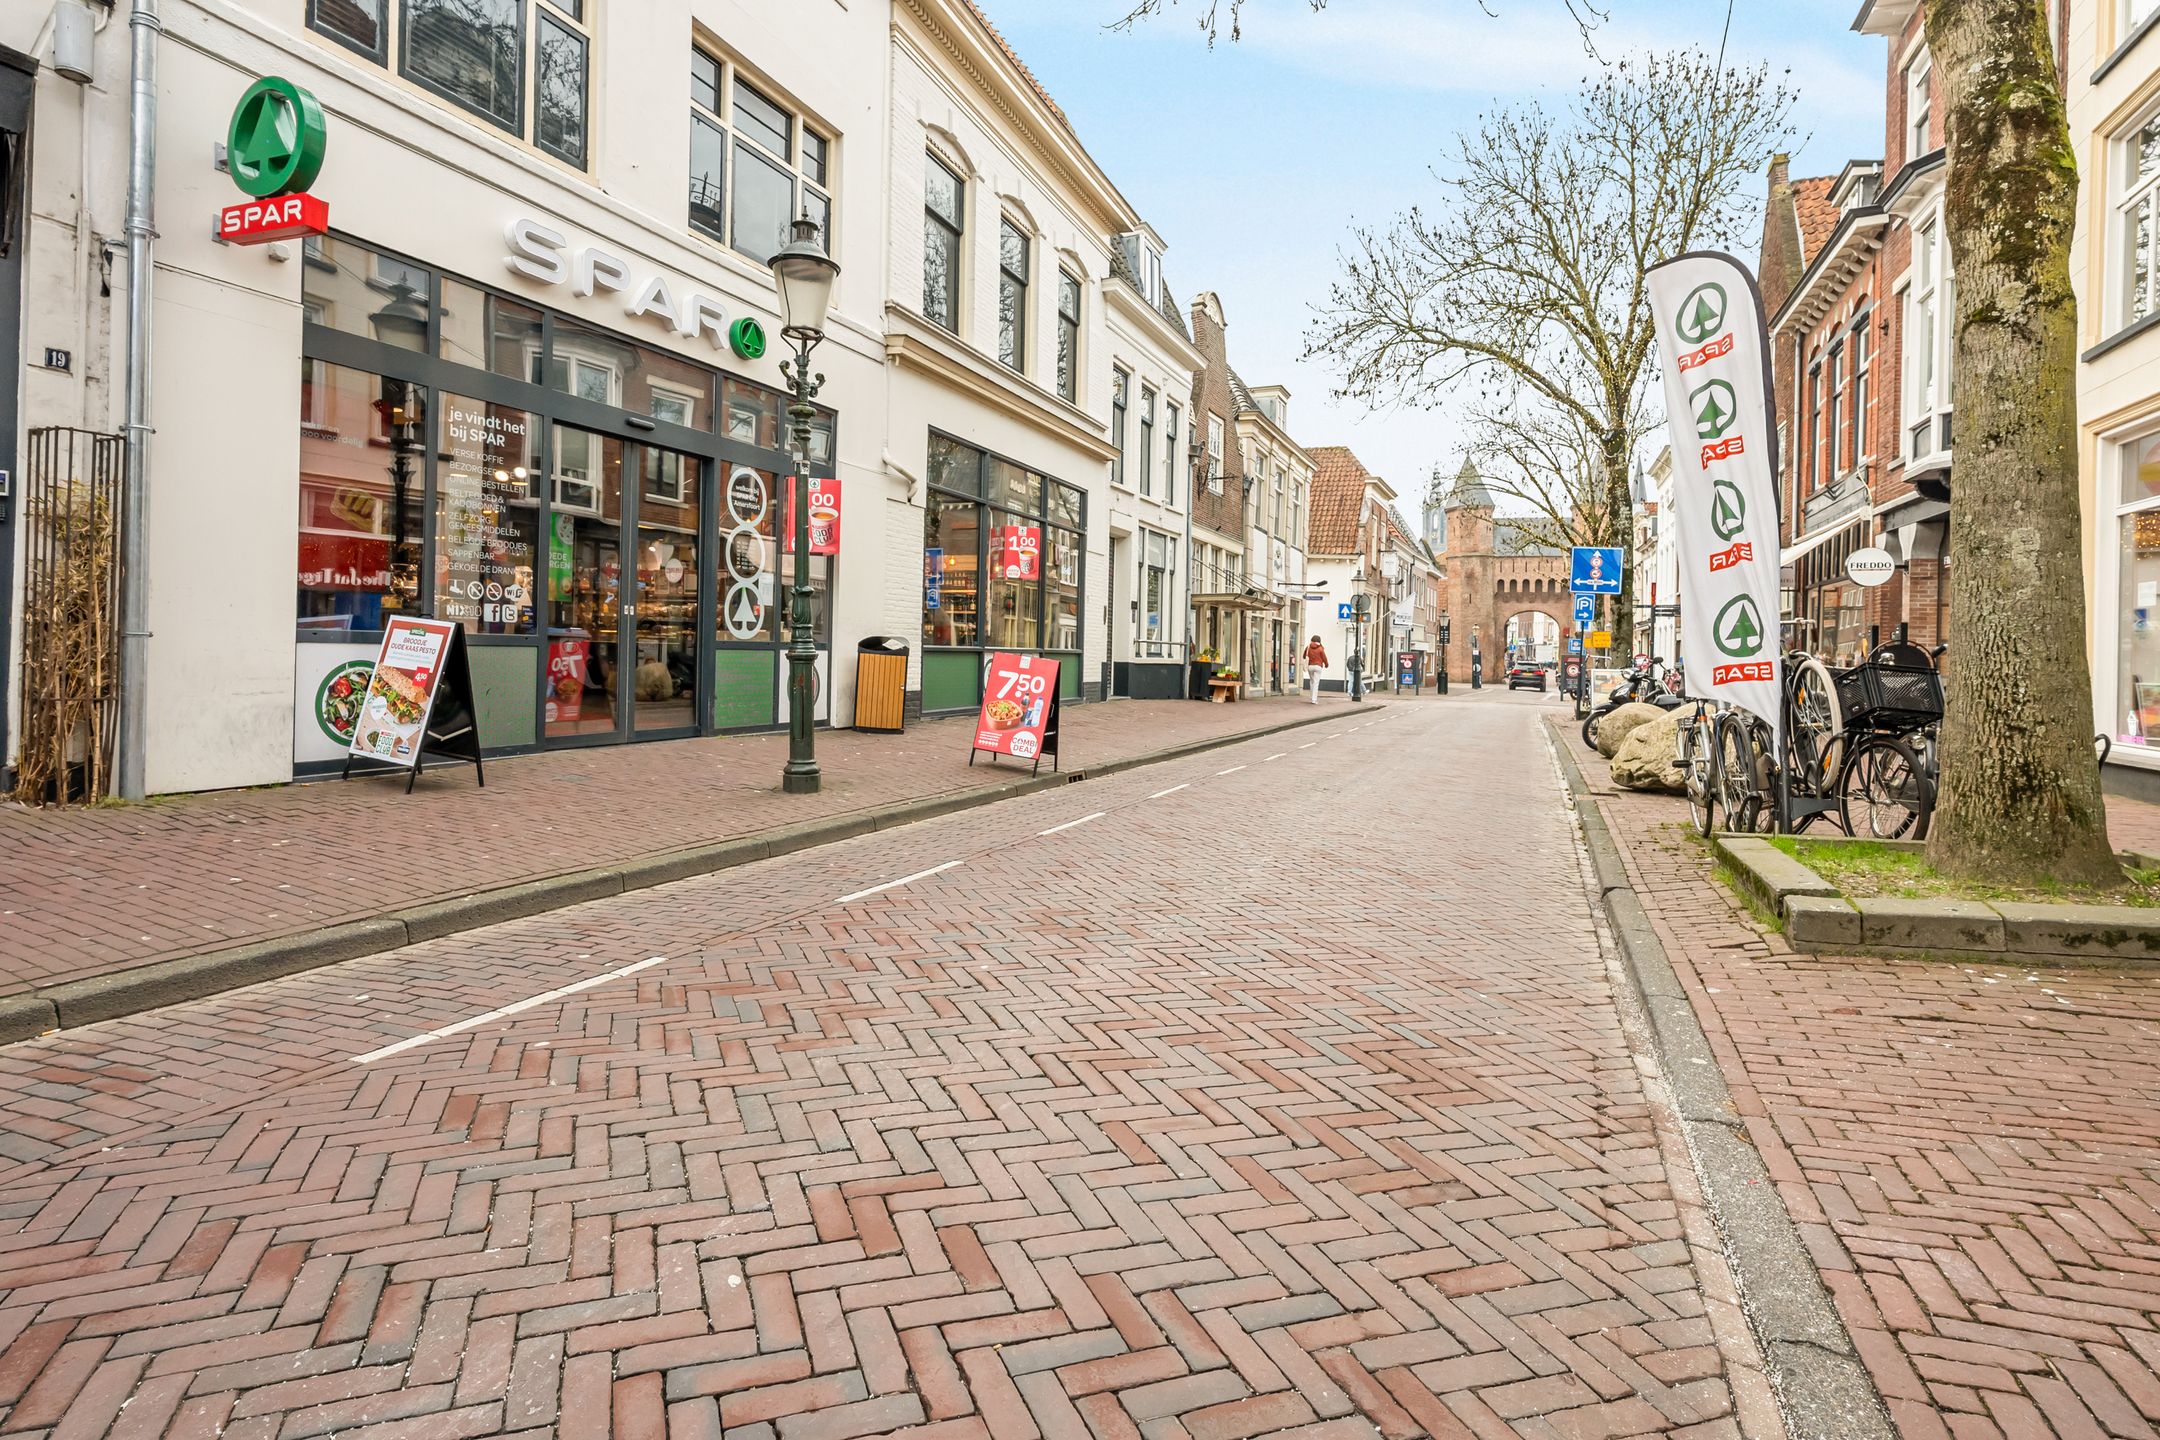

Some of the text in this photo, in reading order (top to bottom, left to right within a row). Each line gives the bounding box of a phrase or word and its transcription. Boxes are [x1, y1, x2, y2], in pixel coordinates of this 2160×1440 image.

[223, 198, 303, 233] SPAR
[503, 218, 732, 351] SPAR
[51, 350, 66, 368] 19
[448, 406, 526, 436] je vindt het
[449, 423, 506, 448] bij SPAR
[449, 447, 505, 465] VERSE KOFFIE
[481, 480, 525, 495] BESTELLEN
[449, 488, 505, 504] BELTEGOED &
[449, 498, 506, 513] KADOBONNEN
[733, 500, 760, 510] Amersfoort
[448, 521, 521, 537] GENEESMIDDELEN
[448, 535, 528, 551] BELEGDE BROODJES
[447, 548, 495, 561] SAPPENBAR
[447, 561, 491, 574] GEKOELDE
[1850, 561, 1892, 569] FREDDO
[1580, 600, 1589, 611] P
[391, 642, 437, 655] OUDE KAAS PESTO
[403, 637, 428, 646] BROODJE
[1013, 744, 1034, 754] DEAL
